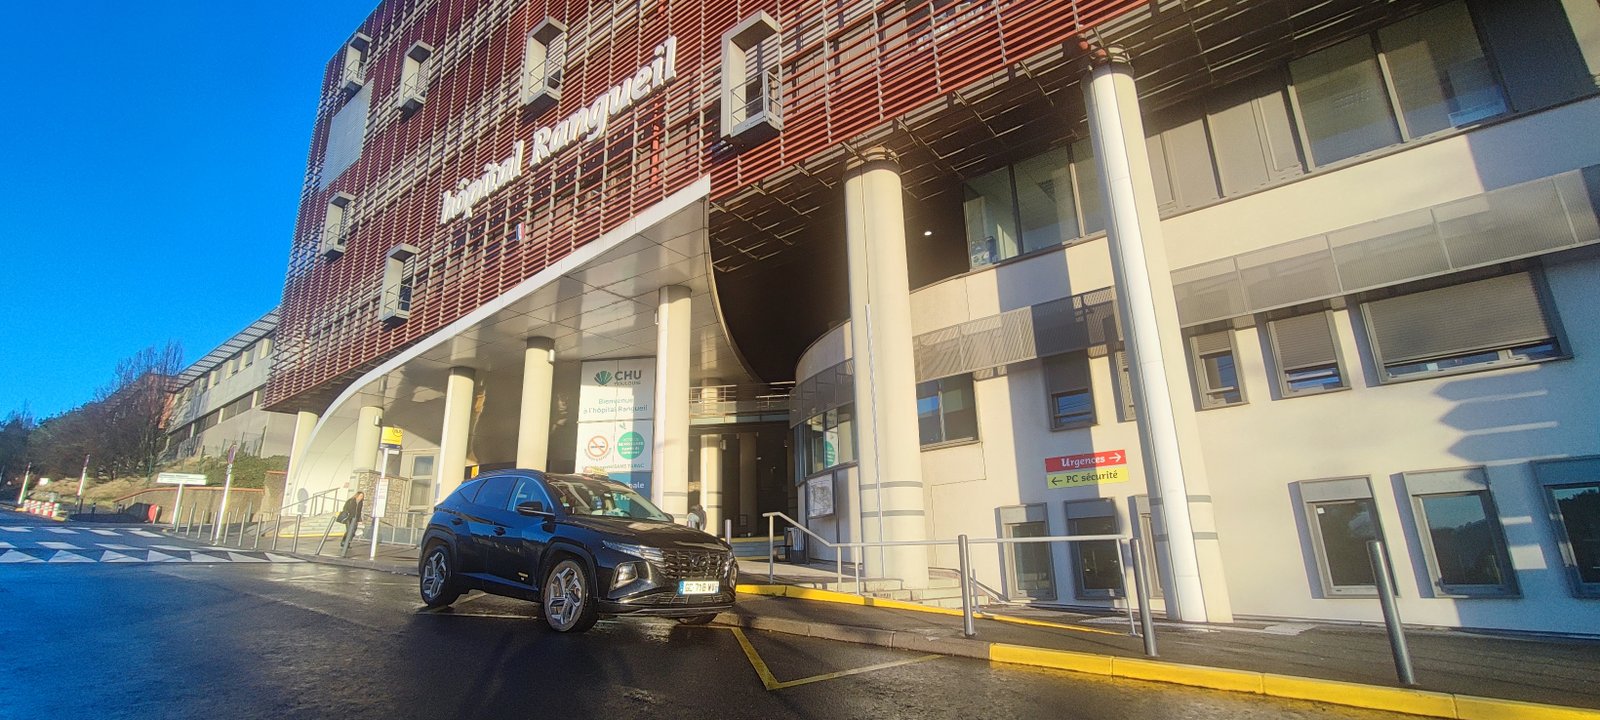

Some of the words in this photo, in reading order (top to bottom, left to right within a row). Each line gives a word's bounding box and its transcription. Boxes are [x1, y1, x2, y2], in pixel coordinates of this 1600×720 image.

[440, 140, 525, 224] hôpital
[530, 35, 678, 166] Rangueil
[614, 370, 642, 380] CHU
[1061, 456, 1105, 468] Urgences
[1066, 475, 1079, 483] PC
[1081, 470, 1118, 482] sécurité
